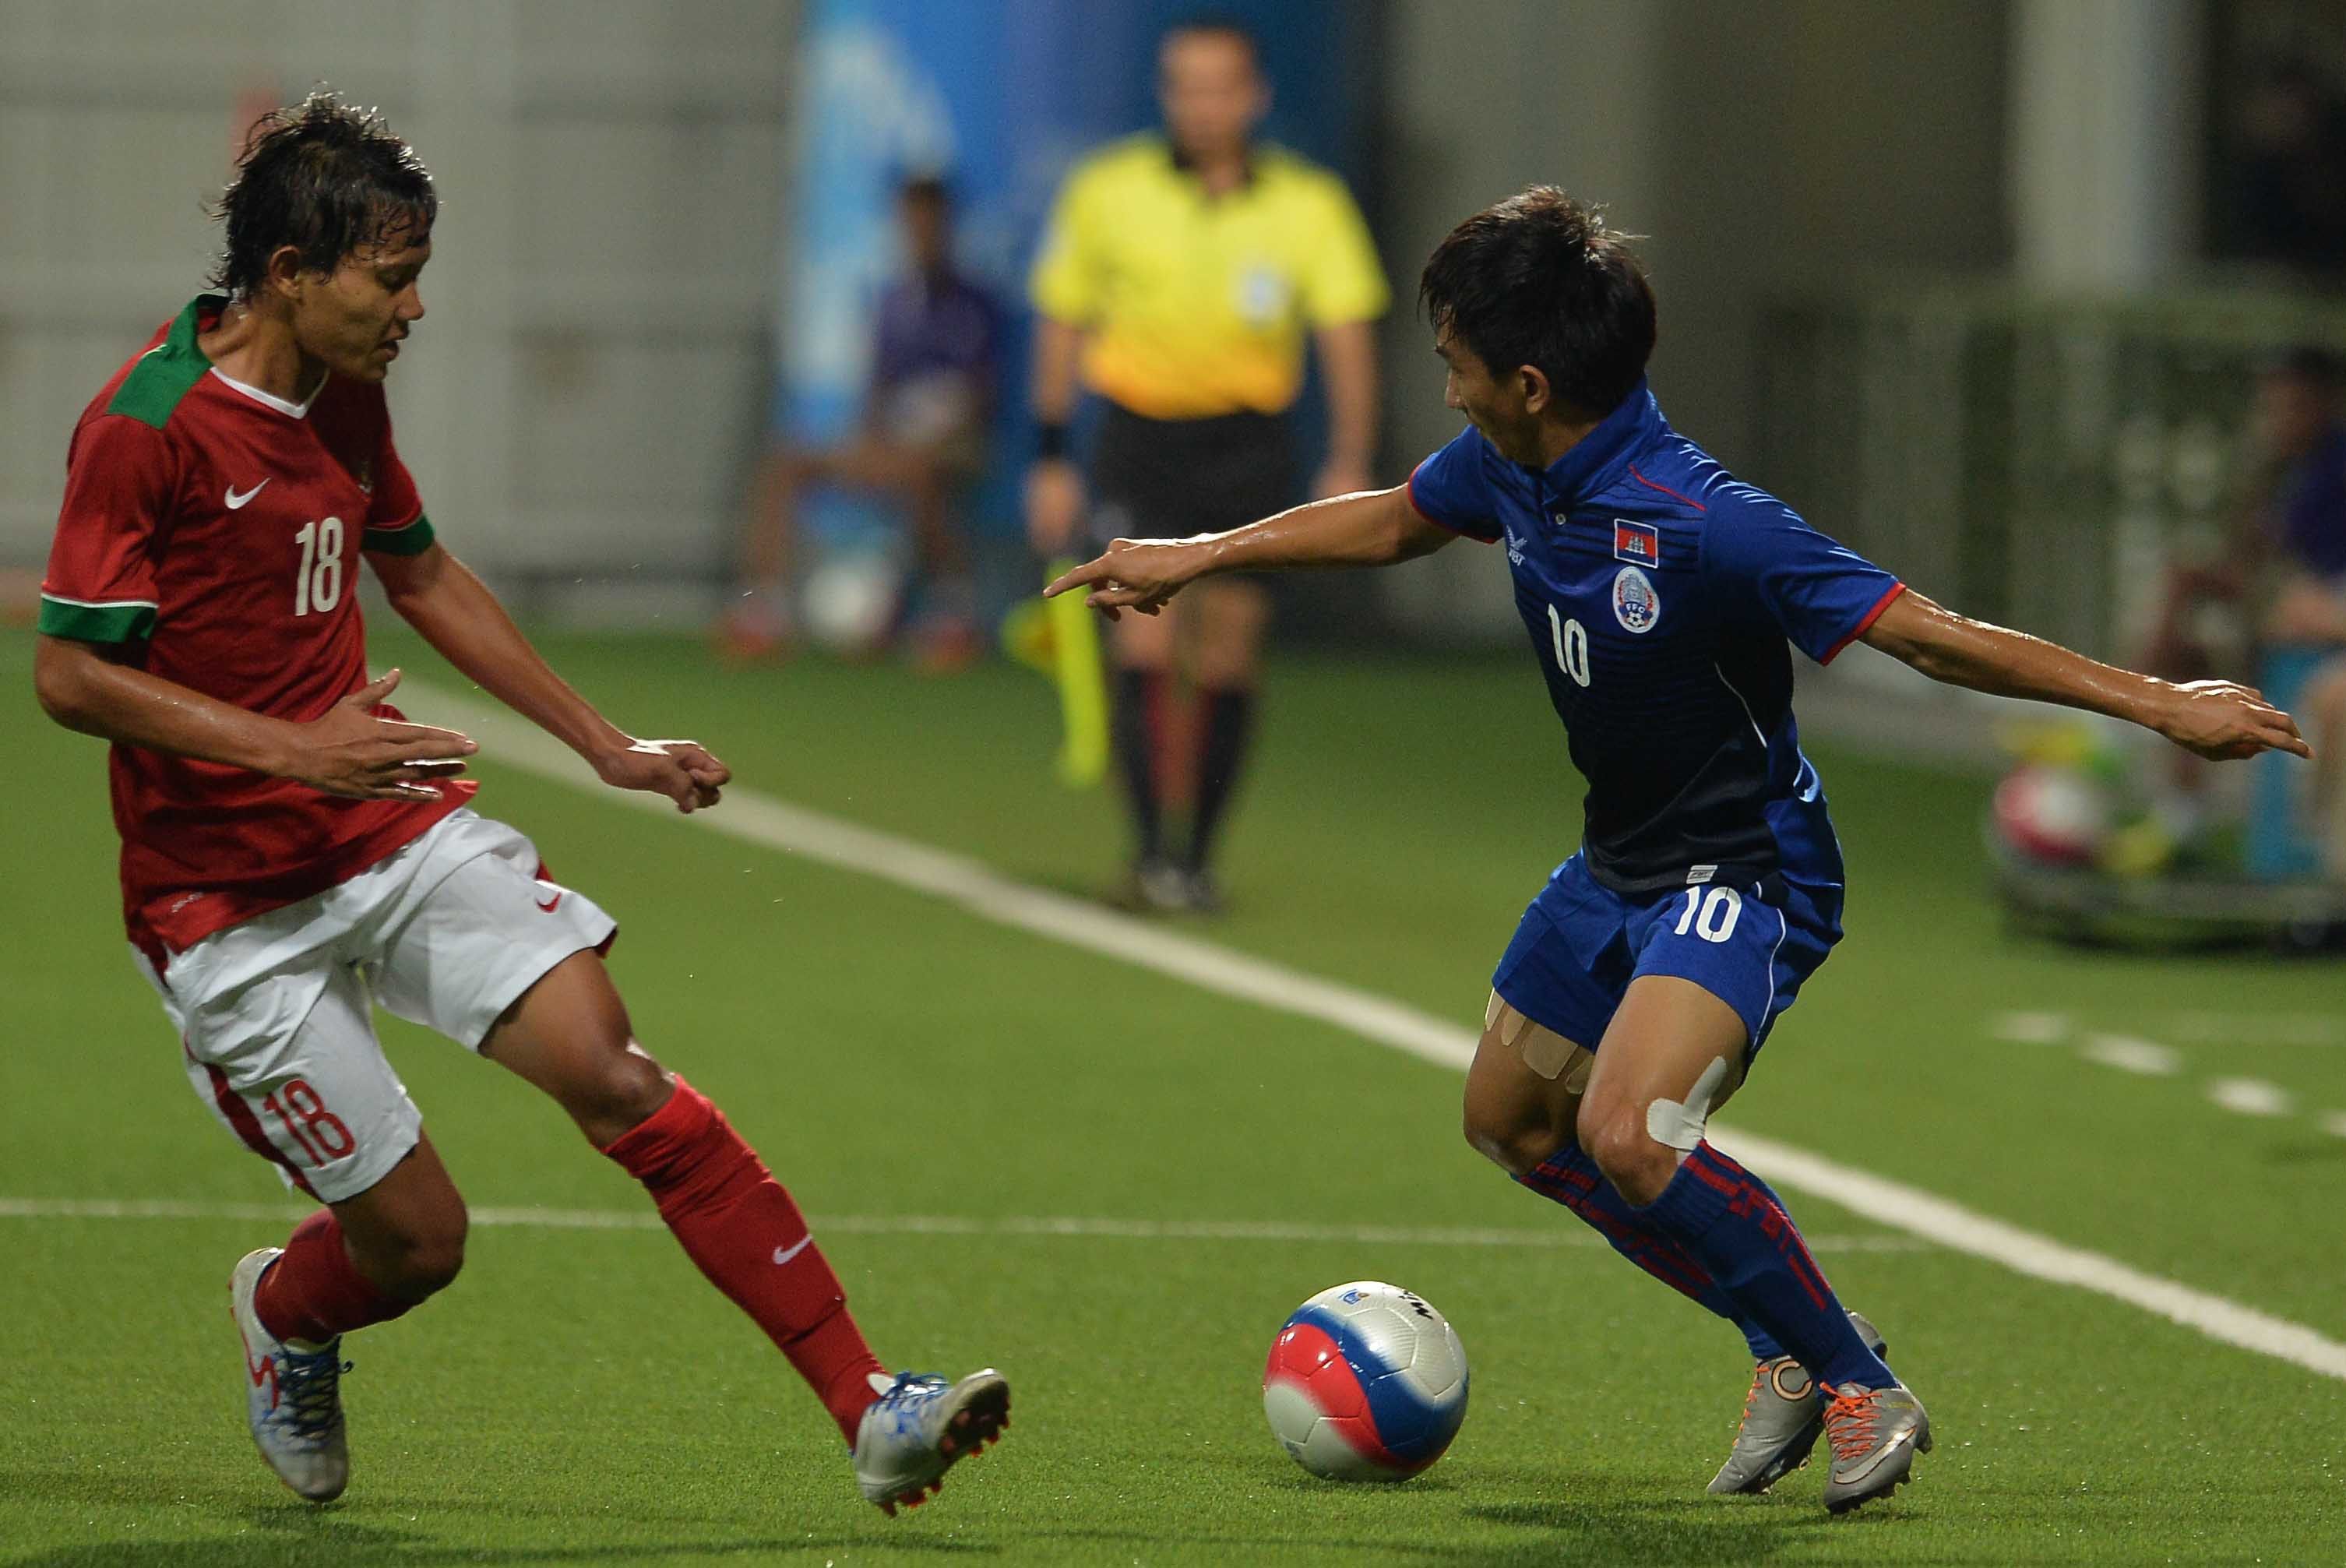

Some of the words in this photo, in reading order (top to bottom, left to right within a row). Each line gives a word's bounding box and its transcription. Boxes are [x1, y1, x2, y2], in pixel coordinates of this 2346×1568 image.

[295, 517, 344, 616] 18
[1548, 603, 1590, 687] 10
[1674, 885, 1742, 943] 10
[263, 1079, 356, 1168] 18
